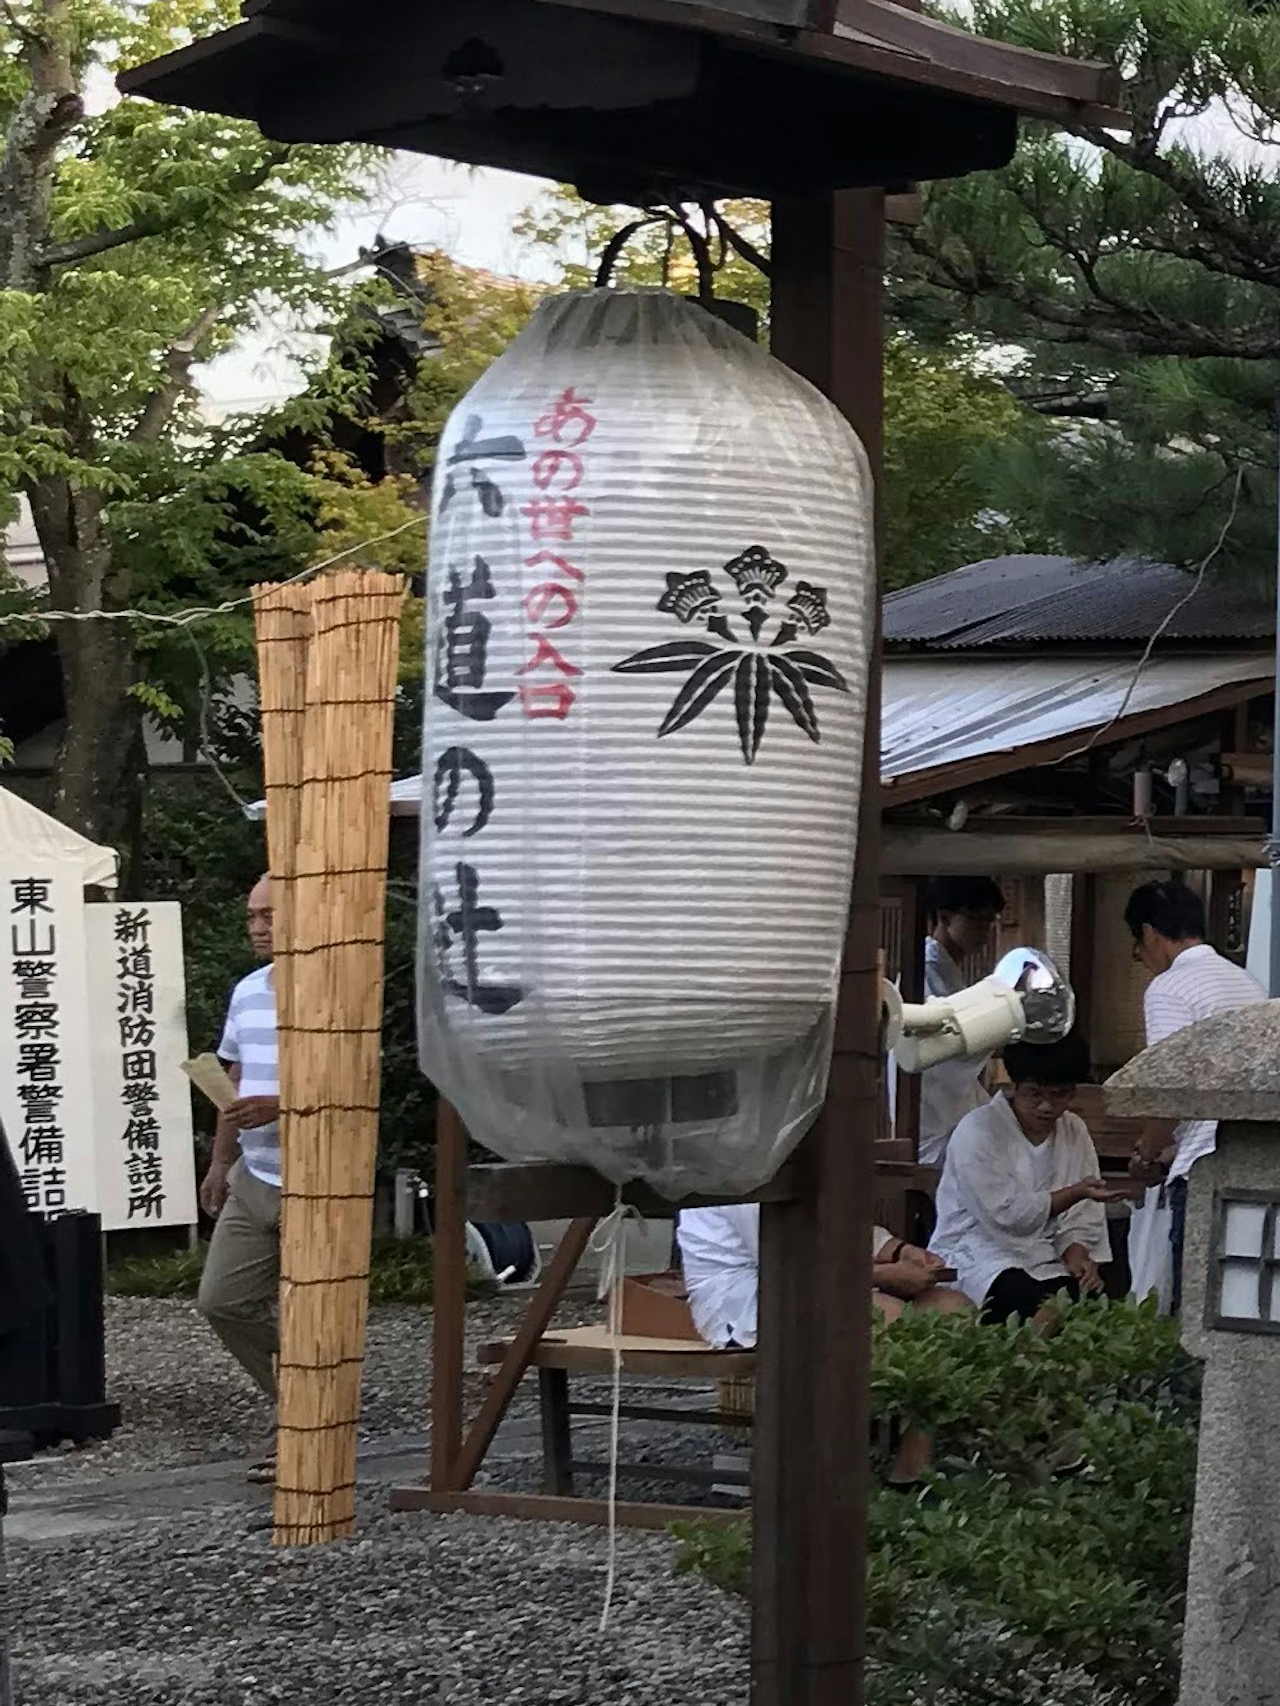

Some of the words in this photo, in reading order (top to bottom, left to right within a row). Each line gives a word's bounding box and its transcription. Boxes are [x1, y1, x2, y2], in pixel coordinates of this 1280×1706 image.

[432, 416, 526, 1015] 六道の辻
[519, 387, 599, 721] あの世への入口
[9, 877, 82, 1221] 東山警察署警備詰
[113, 907, 167, 1220] 新道消防団警備詰所
